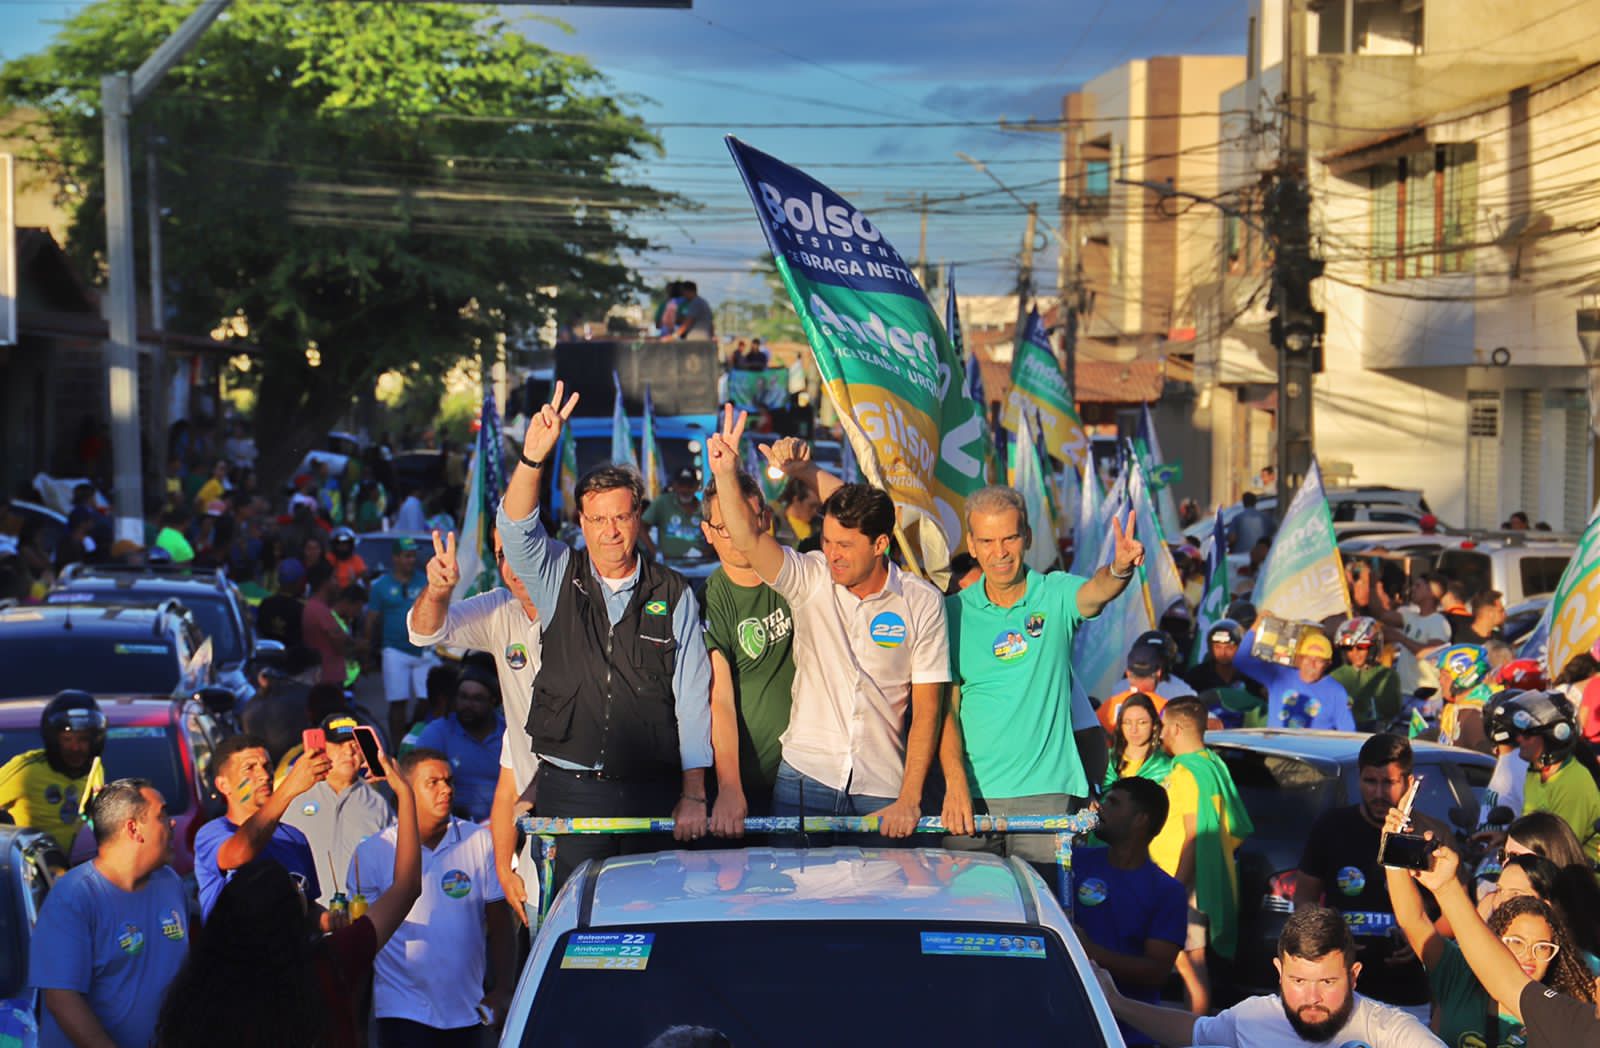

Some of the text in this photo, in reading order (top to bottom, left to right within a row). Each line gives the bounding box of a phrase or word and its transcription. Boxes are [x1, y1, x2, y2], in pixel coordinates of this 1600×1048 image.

[799, 250, 865, 276] BRAGA
[872, 623, 906, 637] 22
[1043, 819, 1069, 829] 22
[622, 934, 646, 944] 22
[952, 936, 996, 945] 2222
[619, 946, 642, 956] 22
[603, 957, 640, 968] 222
